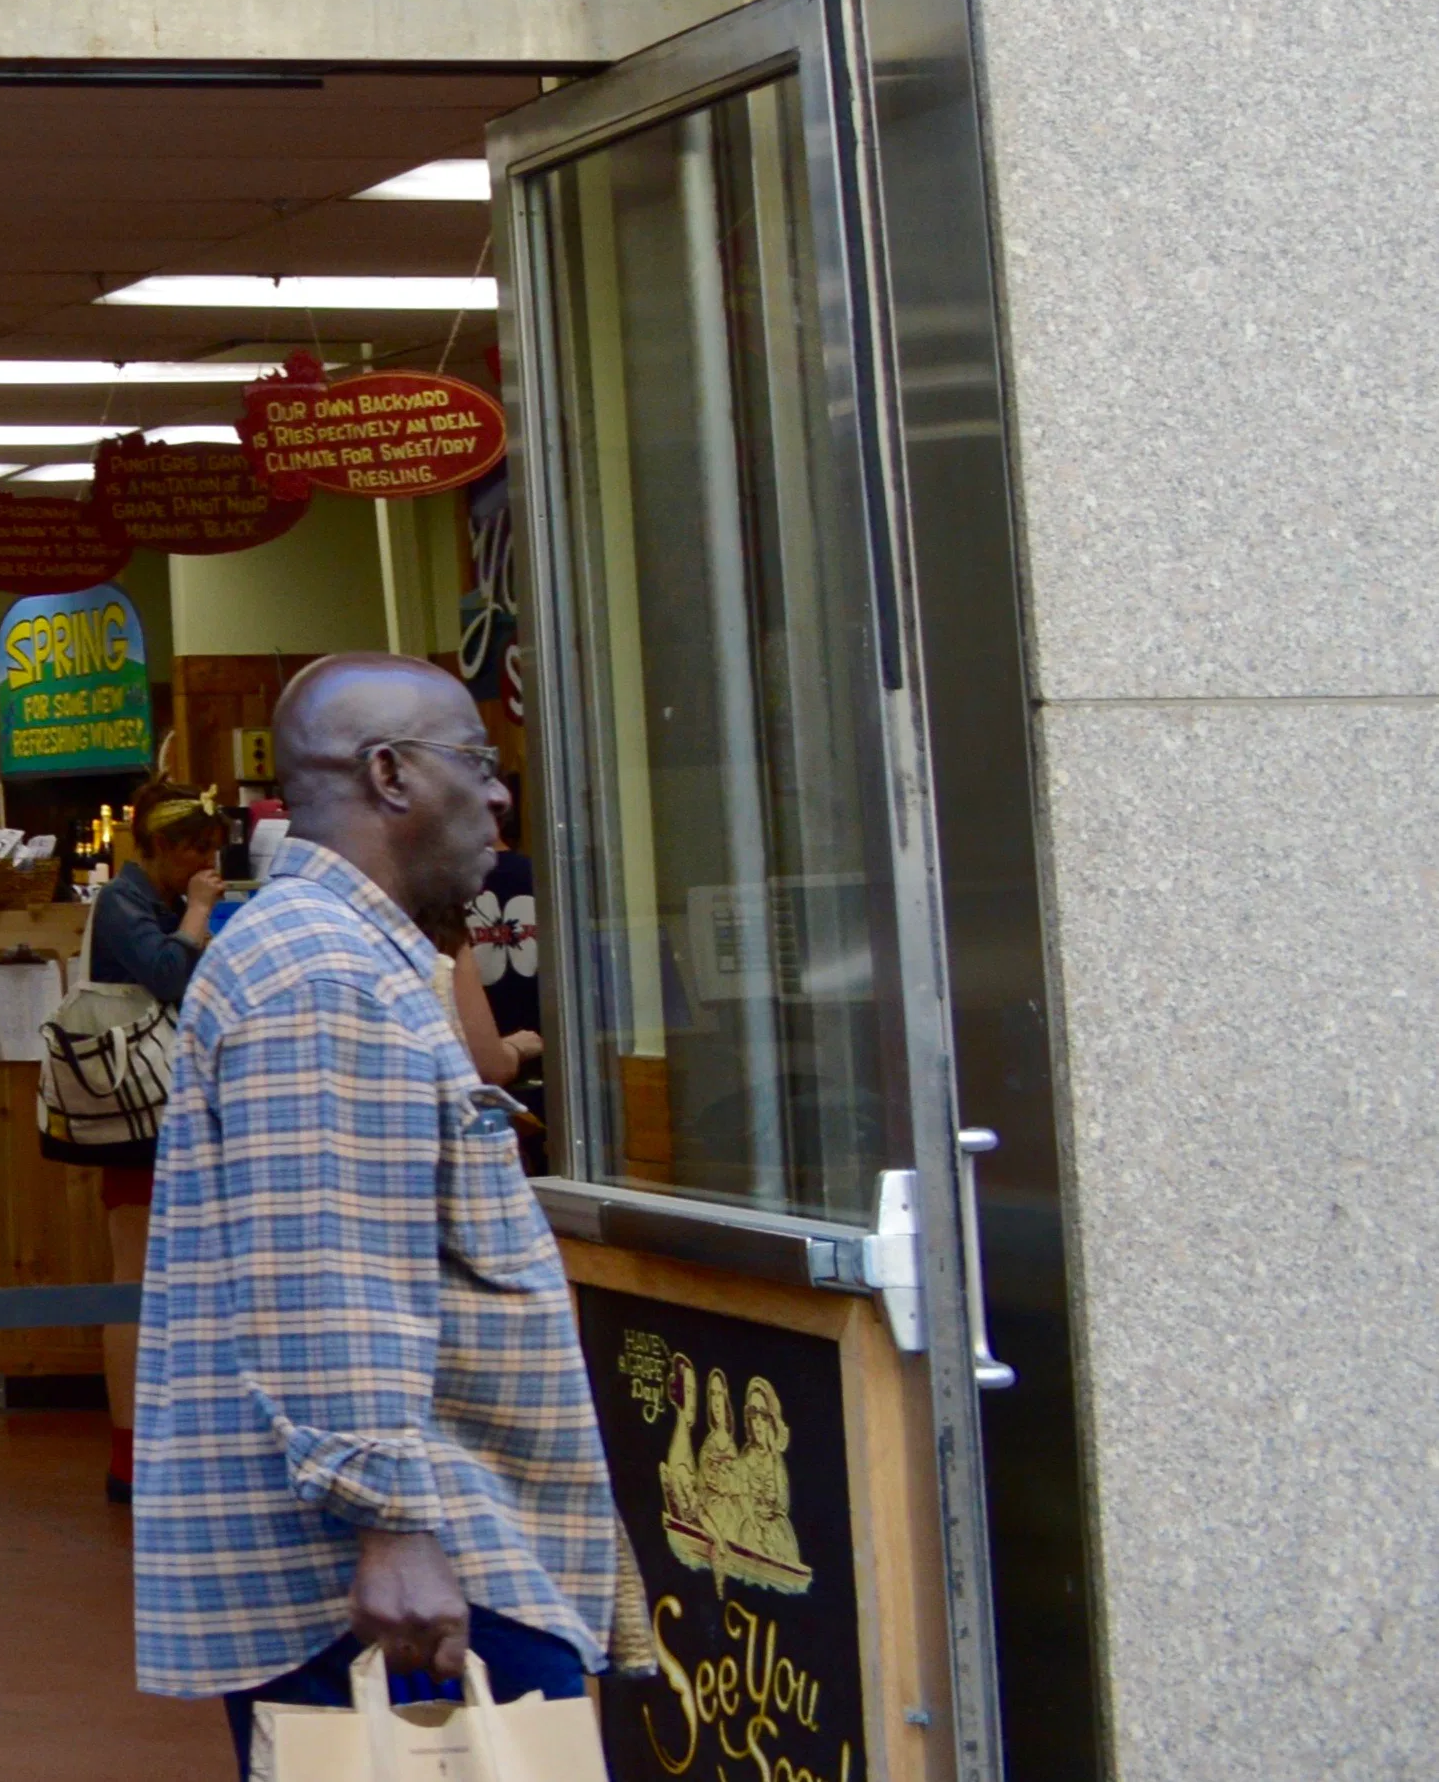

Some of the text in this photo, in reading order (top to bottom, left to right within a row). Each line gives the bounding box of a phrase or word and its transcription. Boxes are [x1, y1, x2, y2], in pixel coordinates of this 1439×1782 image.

[267, 389, 450, 424] OUR OWN BACKYARD
[252, 432, 268, 450] IS
[405, 416, 429, 436] AN
[430, 410, 483, 432] IDEAL
[265, 448, 338, 473] CLIMATE
[340, 447, 375, 467] FOR
[4, 601, 130, 692] SPRING
[22, 693, 50, 723] FOR
[640, 1593, 822, 1776] See You
